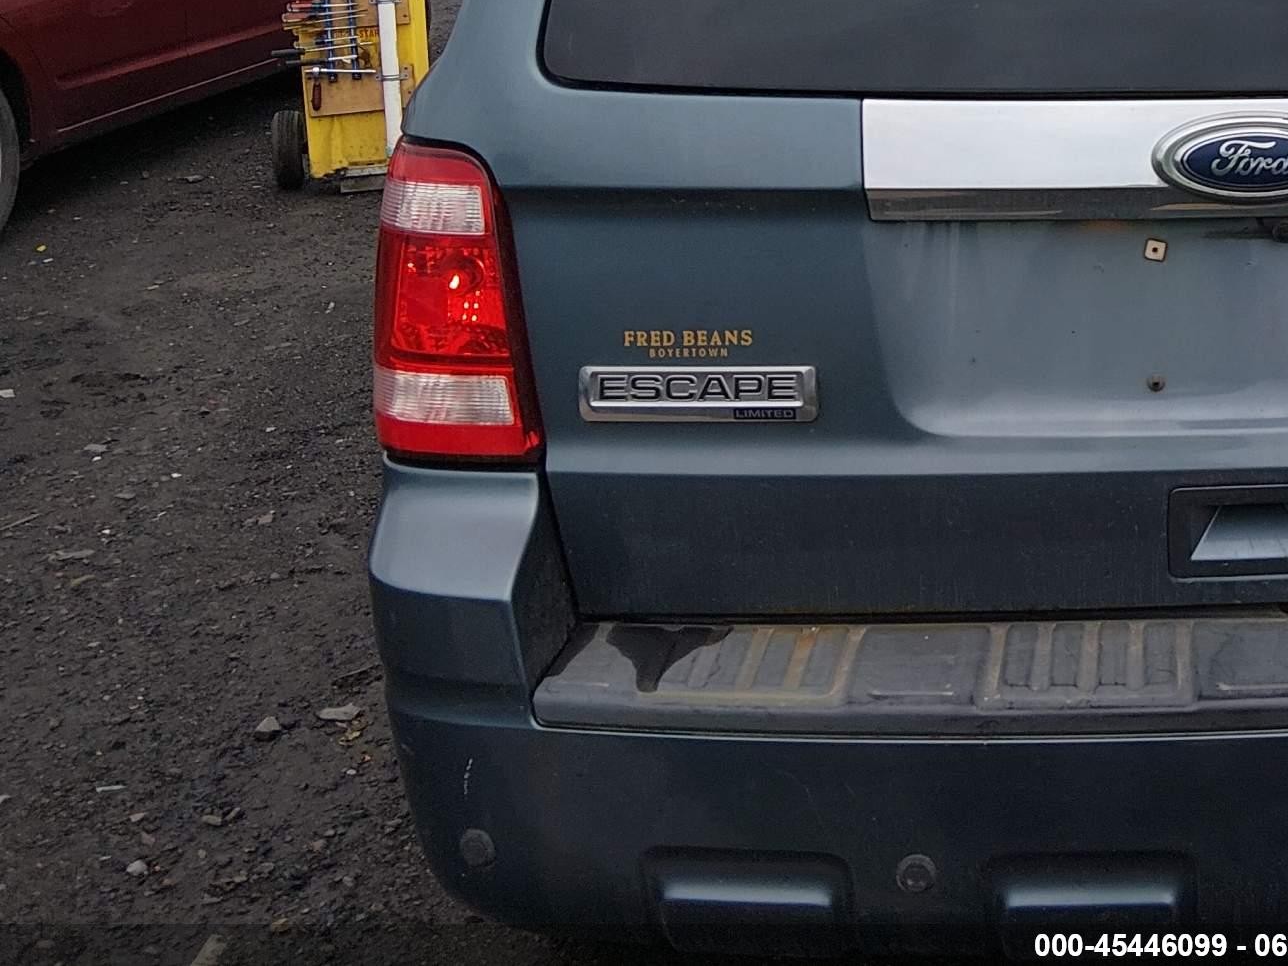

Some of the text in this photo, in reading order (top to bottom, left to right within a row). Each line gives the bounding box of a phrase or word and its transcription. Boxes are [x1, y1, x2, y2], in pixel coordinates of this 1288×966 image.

[624, 330, 754, 347] FRED BEANS
[649, 348, 729, 359] BOYERTOWN
[598, 375, 799, 402] ESCAPE
[735, 409, 795, 420] LIMITED
